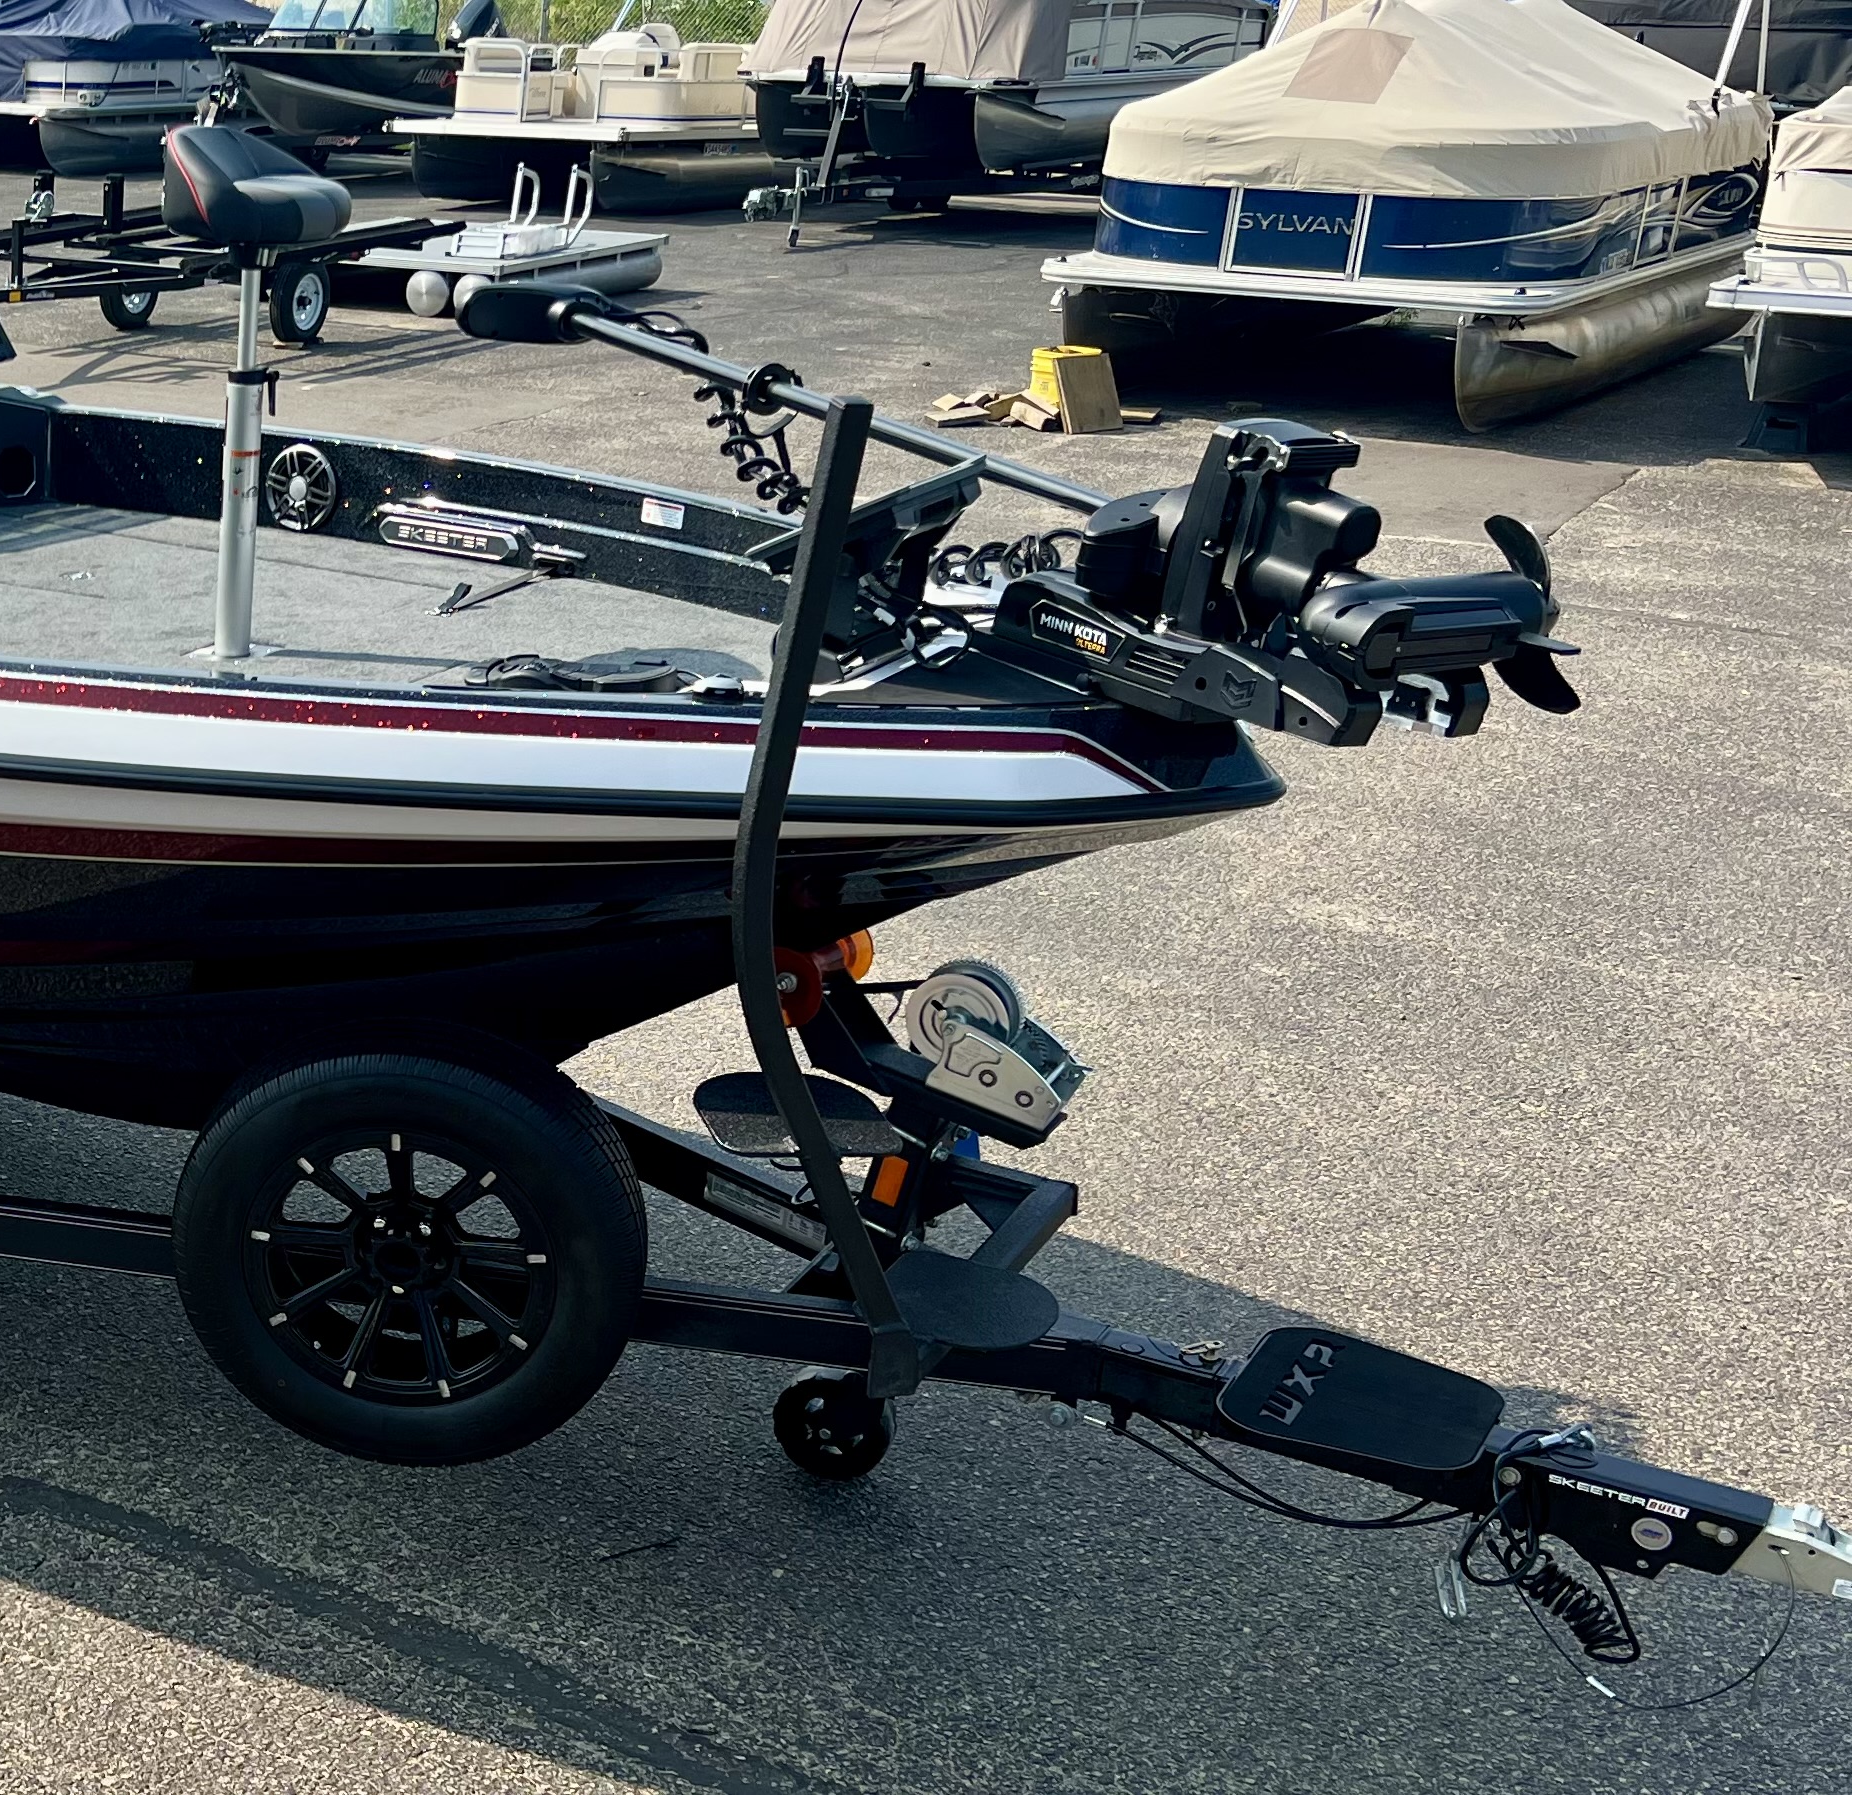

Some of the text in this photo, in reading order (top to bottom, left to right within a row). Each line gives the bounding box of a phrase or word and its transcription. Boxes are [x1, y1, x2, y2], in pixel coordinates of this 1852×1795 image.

[1237, 212, 1356, 237] SYLVAN
[397, 525, 488, 551] SKEETER
[1039, 612, 1108, 646] MINN KOTA
[1259, 1338, 1346, 1426] WXR
[1548, 1473, 1688, 1518] SKEETER BUILT
